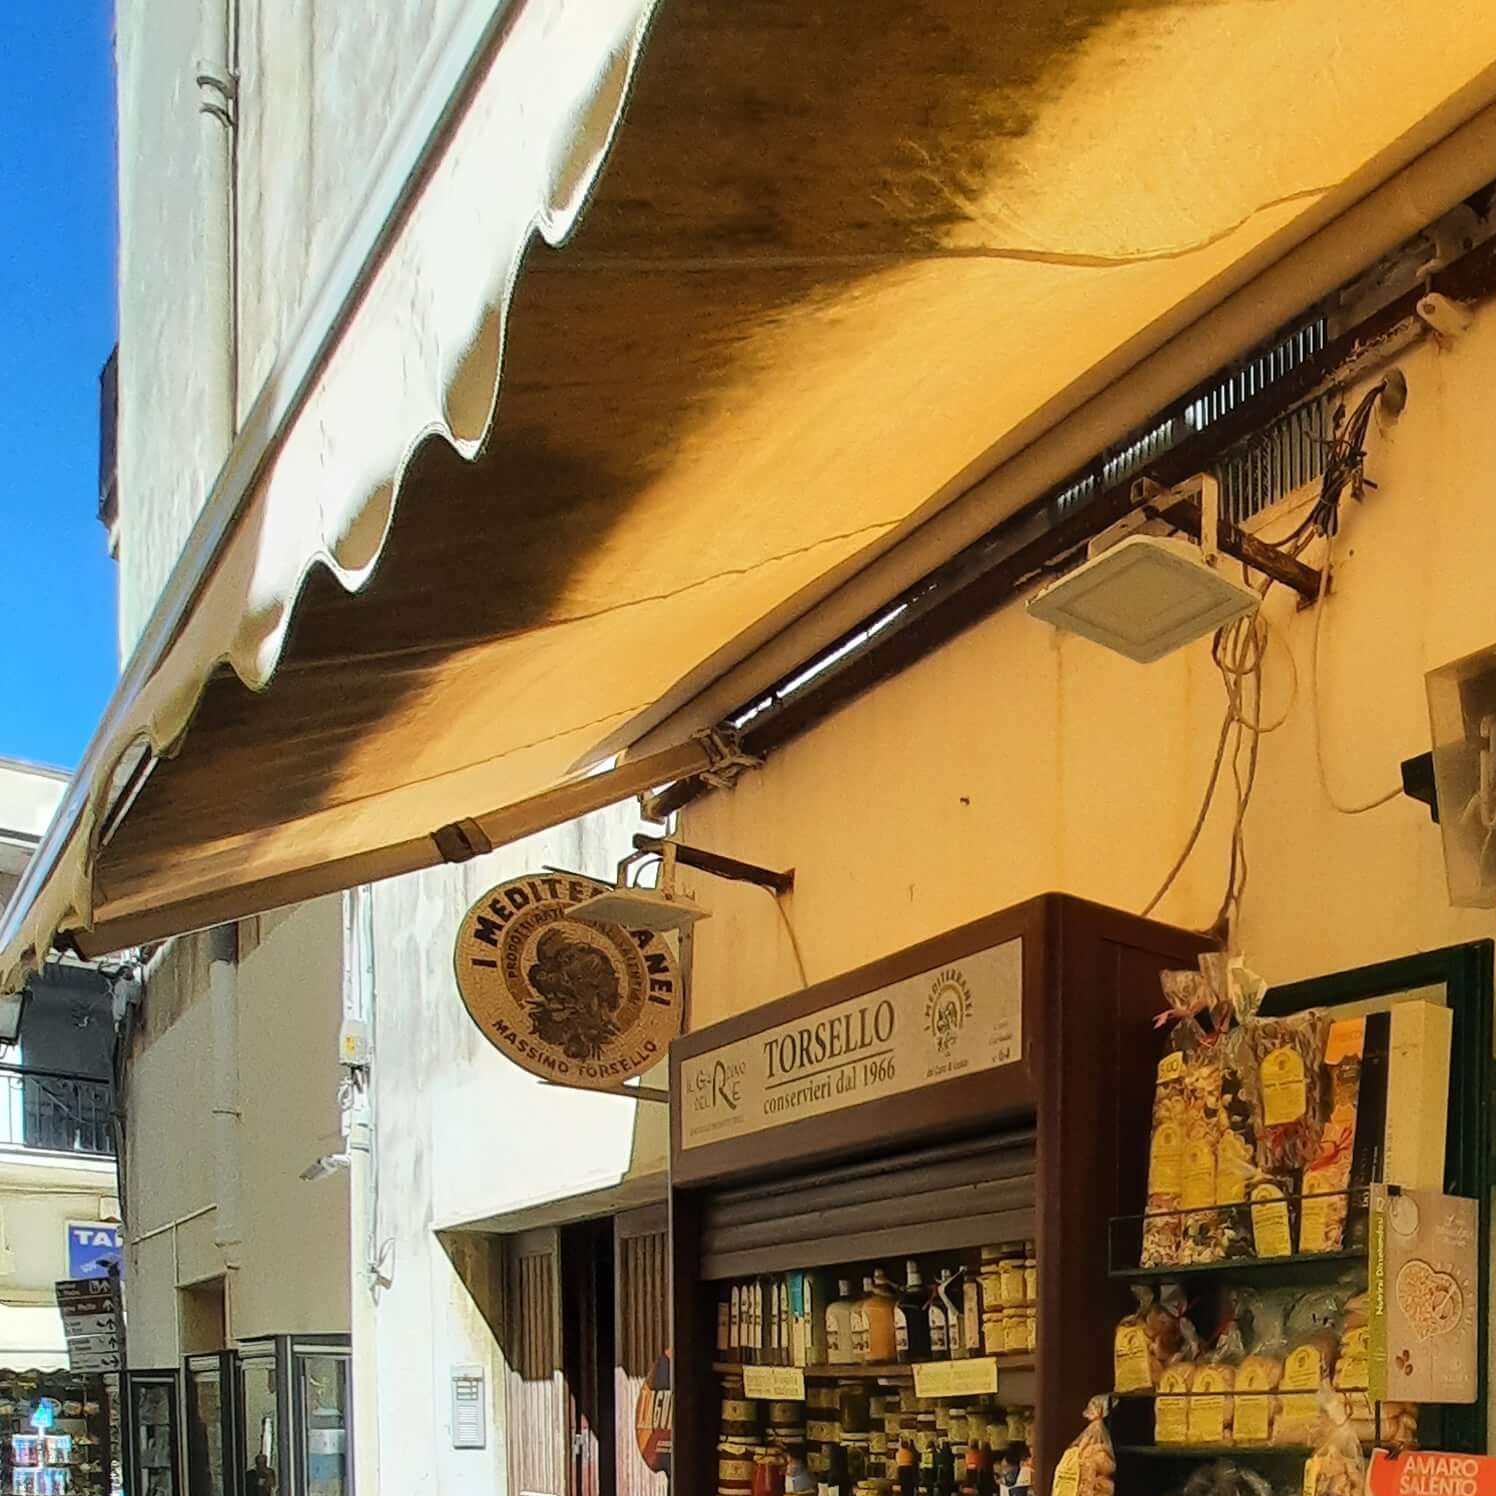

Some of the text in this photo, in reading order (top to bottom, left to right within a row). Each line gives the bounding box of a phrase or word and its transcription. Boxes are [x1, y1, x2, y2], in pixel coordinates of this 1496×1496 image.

[473, 878, 673, 1007] MEDITEANEI
[492, 1018, 657, 1078] MASSIMO TORSELLO
[763, 999, 895, 1079] TORSELLO
[763, 1075, 832, 1115] conservieri
[836, 1066, 857, 1094] dal
[863, 1057, 896, 1087] 1966
[1403, 1454, 1479, 1478] AMARO
